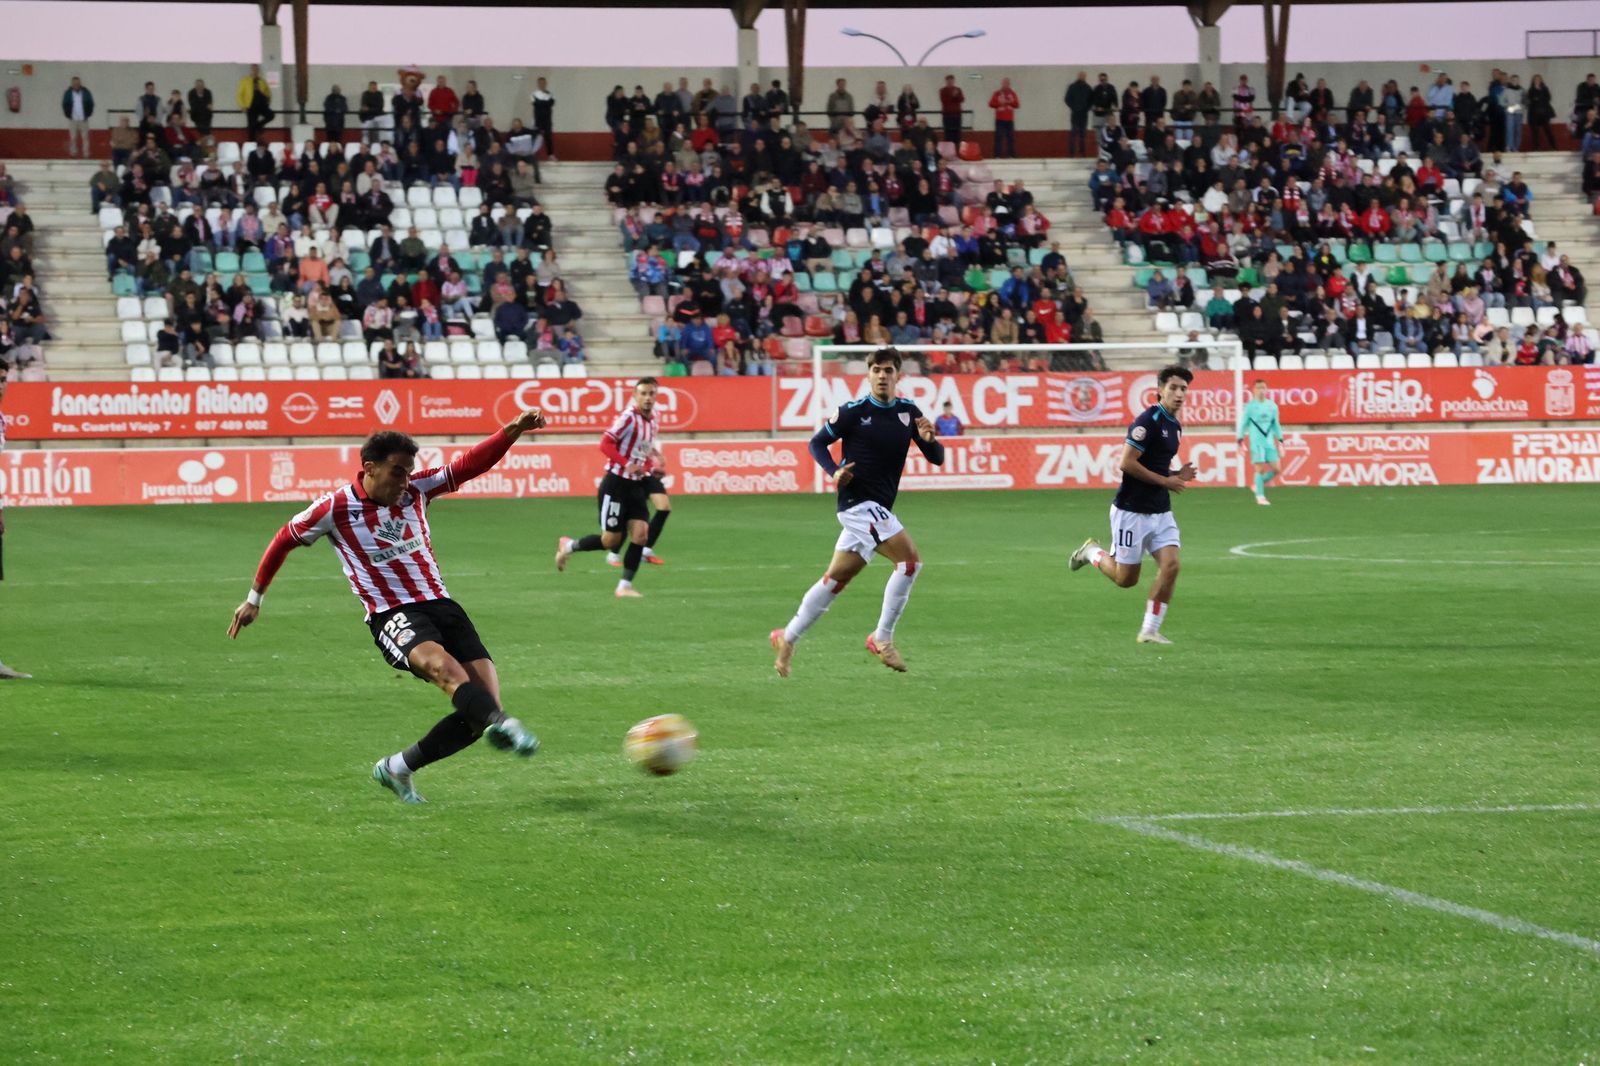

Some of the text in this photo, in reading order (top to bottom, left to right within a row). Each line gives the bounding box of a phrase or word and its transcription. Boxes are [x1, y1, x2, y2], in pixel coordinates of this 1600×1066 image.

[514, 380, 678, 412] CarDia
[1242, 384, 1318, 406] ÓTICO
[1355, 371, 1422, 401] fisio
[51, 384, 268, 416] Saneamientos Atilano
[420, 396, 451, 407] Grupo
[780, 376, 1038, 427] ZAMRA CF
[1356, 394, 1433, 417] readapt
[1441, 396, 1528, 418] podoactiva
[328, 411, 365, 419] DACIA
[421, 406, 483, 418] Leomotor
[545, 415, 597, 424] UTIDOS
[1182, 406, 1236, 422] ROBE
[81, 421, 127, 432] Cuartel
[129, 420, 160, 433] Viejo
[162, 420, 171, 431] 7
[502, 449, 551, 470] Joven
[680, 446, 798, 468] Escuela
[297, 478, 331, 489] Junta
[684, 470, 799, 492] infantil
[1318, 462, 1439, 487] ZAMORA
[142, 480, 214, 499] juventud
[263, 490, 308, 502] Castilla
[459, 473, 569, 498] astilla y León
[867, 506, 889, 522] 18
[1119, 529, 1133, 548] 10
[384, 612, 412, 639] 22
